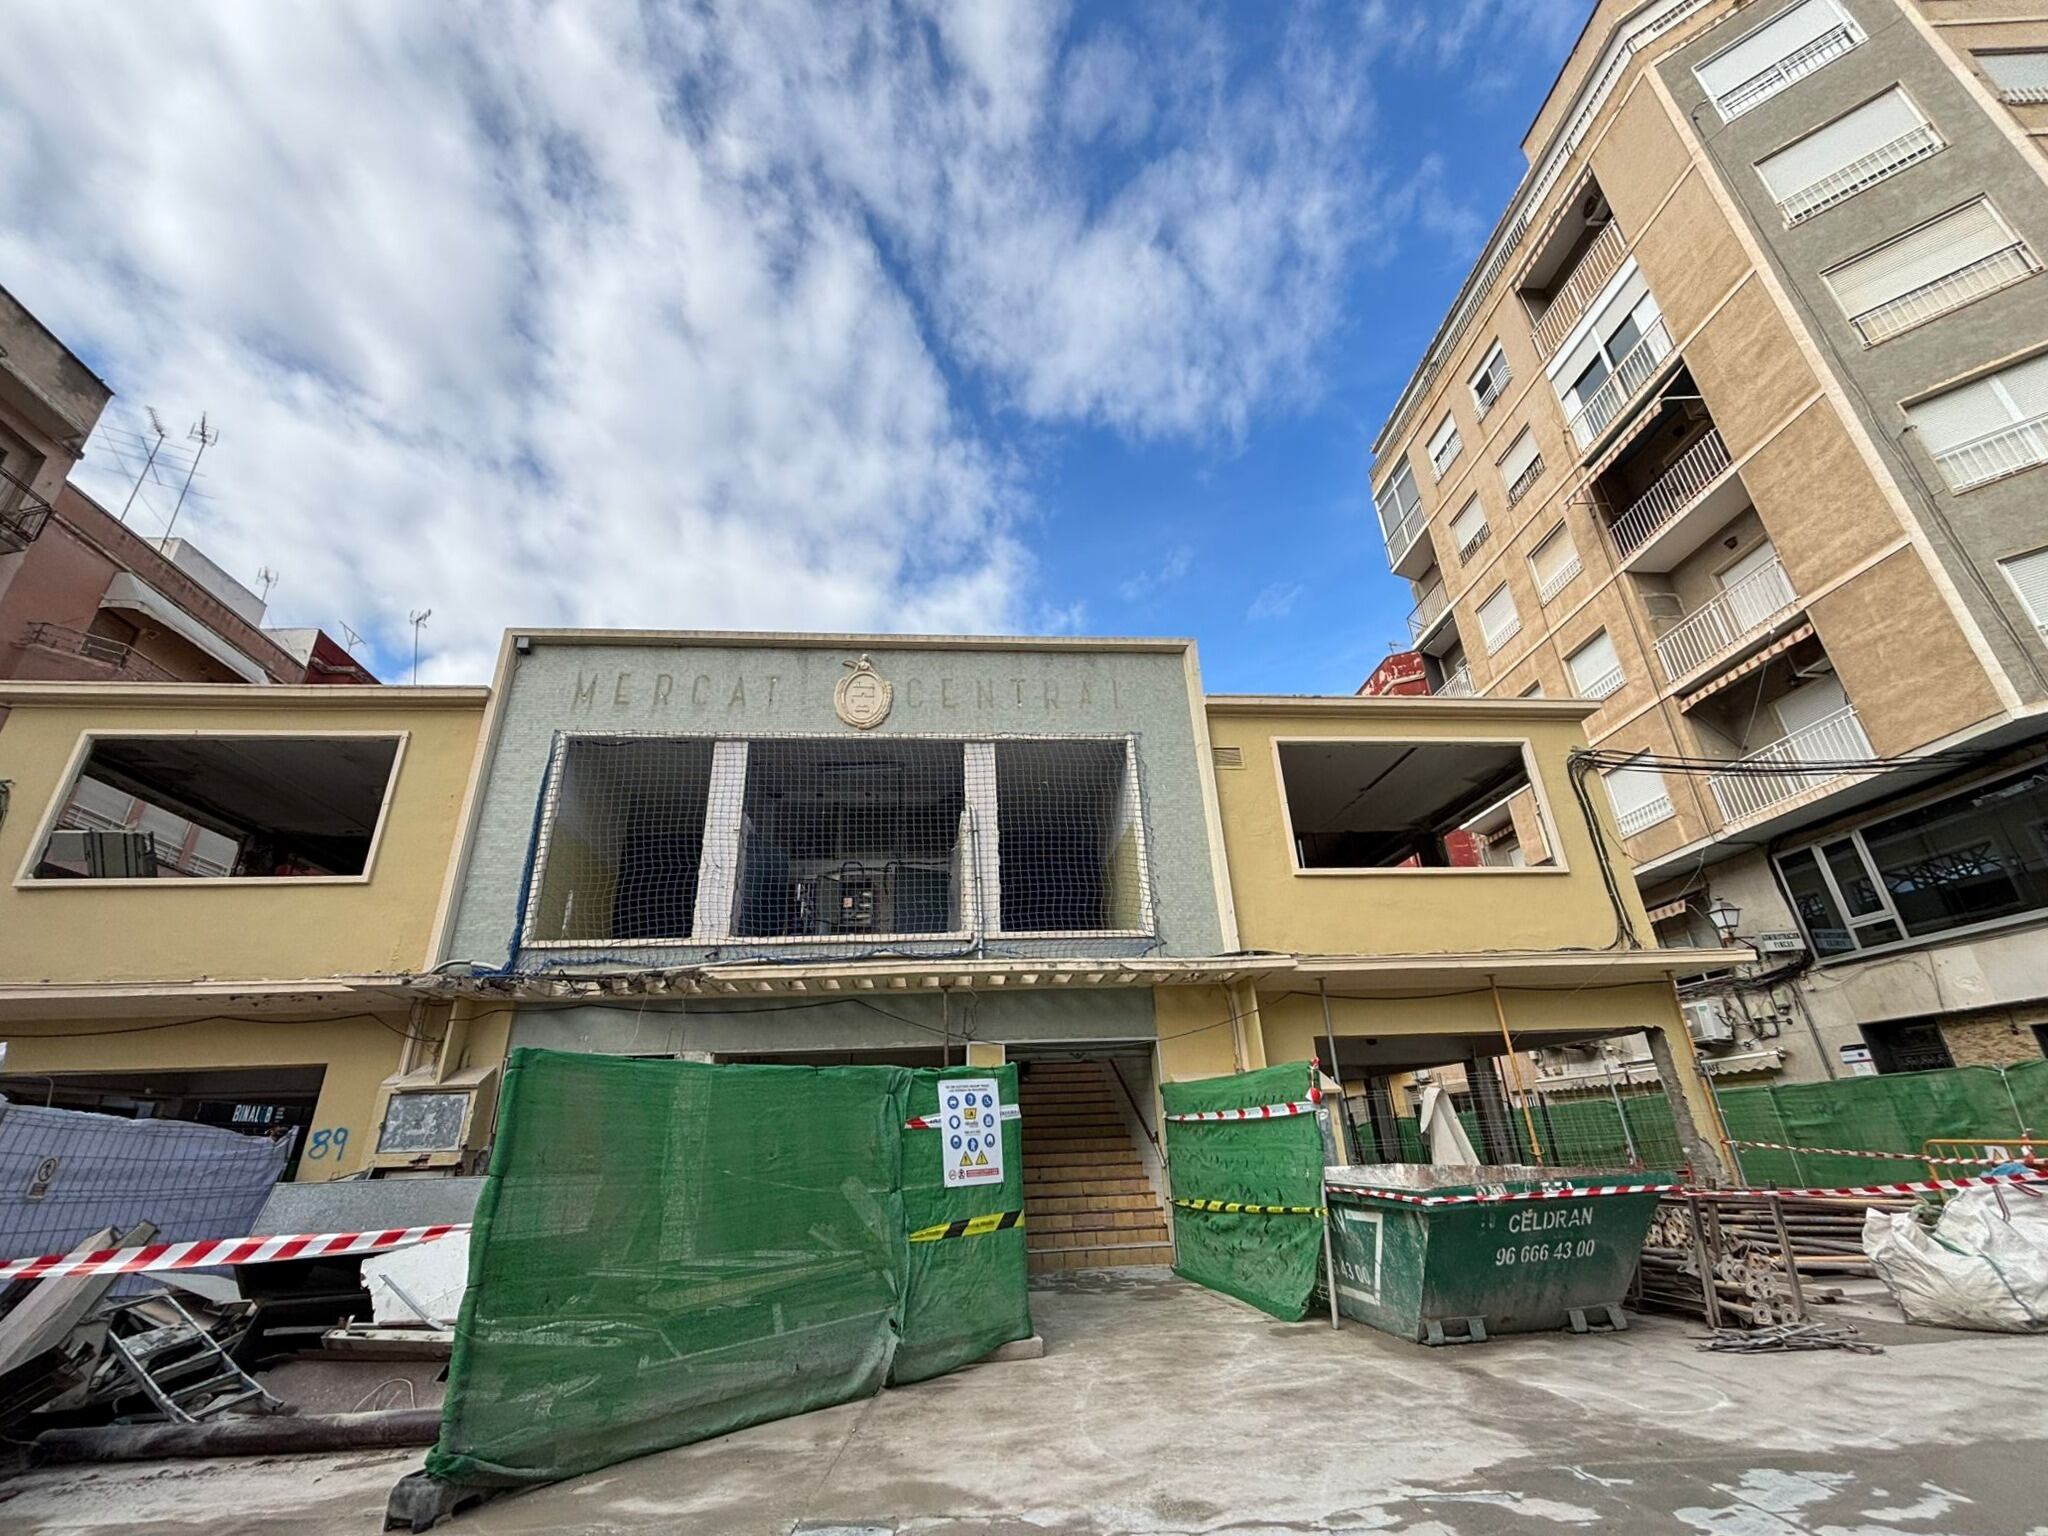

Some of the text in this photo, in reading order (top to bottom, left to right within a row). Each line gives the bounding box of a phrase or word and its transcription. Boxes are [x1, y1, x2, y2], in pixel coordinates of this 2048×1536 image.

[570, 671, 1122, 712] MERCAT CENTRAL
[308, 1127, 348, 1161] 89
[1508, 1207, 1593, 1233] CELDRAN
[1495, 1239, 1595, 1266] 96 666 43 00
